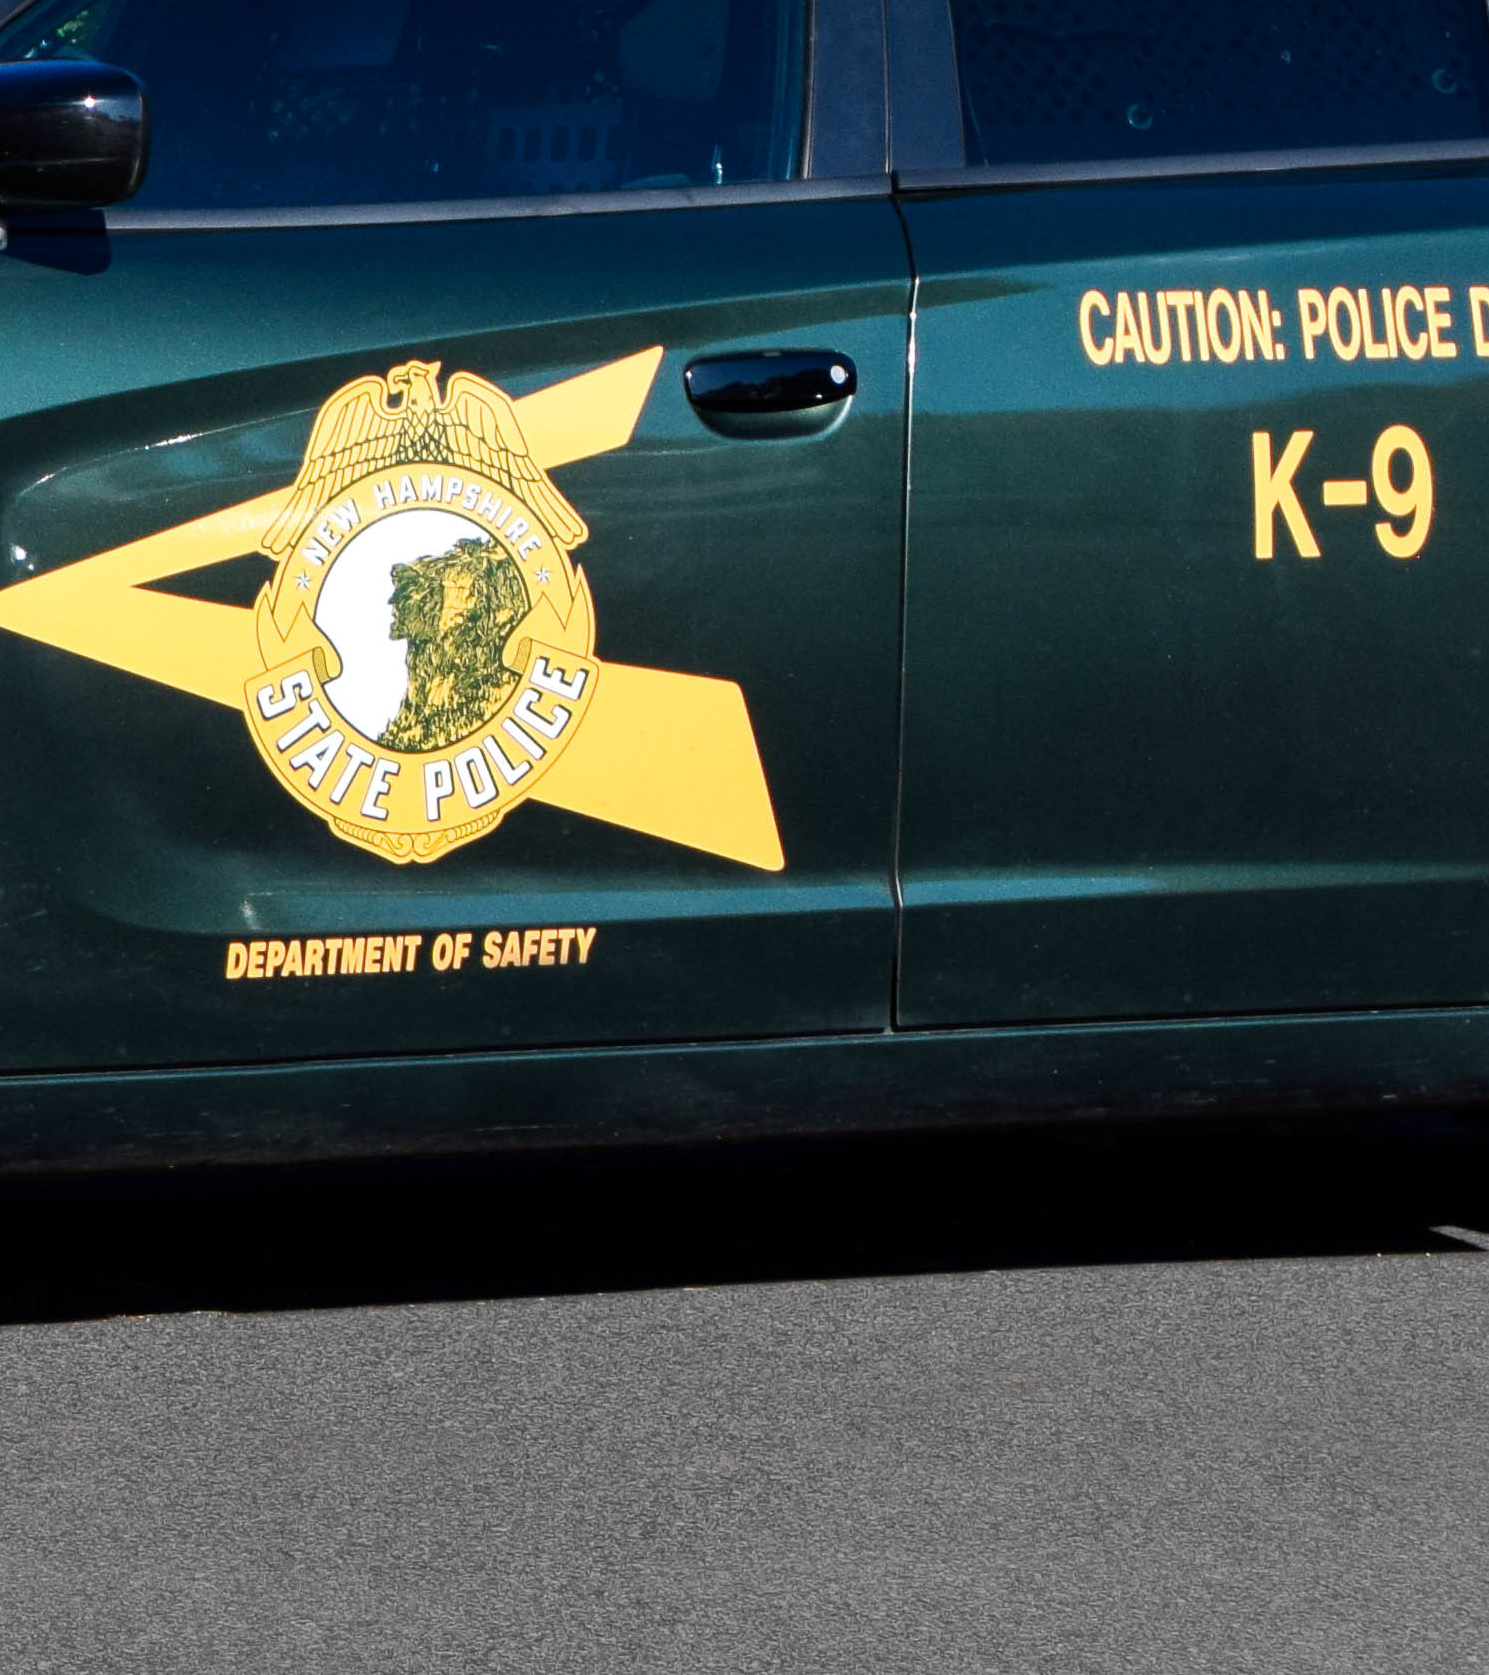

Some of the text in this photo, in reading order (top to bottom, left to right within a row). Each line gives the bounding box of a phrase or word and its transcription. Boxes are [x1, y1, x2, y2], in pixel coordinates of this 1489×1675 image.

[1078, 287, 1287, 367] CAUTION:
[1298, 284, 1458, 362] POLICE
[302, 475, 543, 567] NEW HAMPSHIRE
[1250, 423, 1435, 561] K-9
[257, 657, 590, 822] STATE POLICE
[224, 927, 598, 981] DEPARTMENT OF SAFETY
